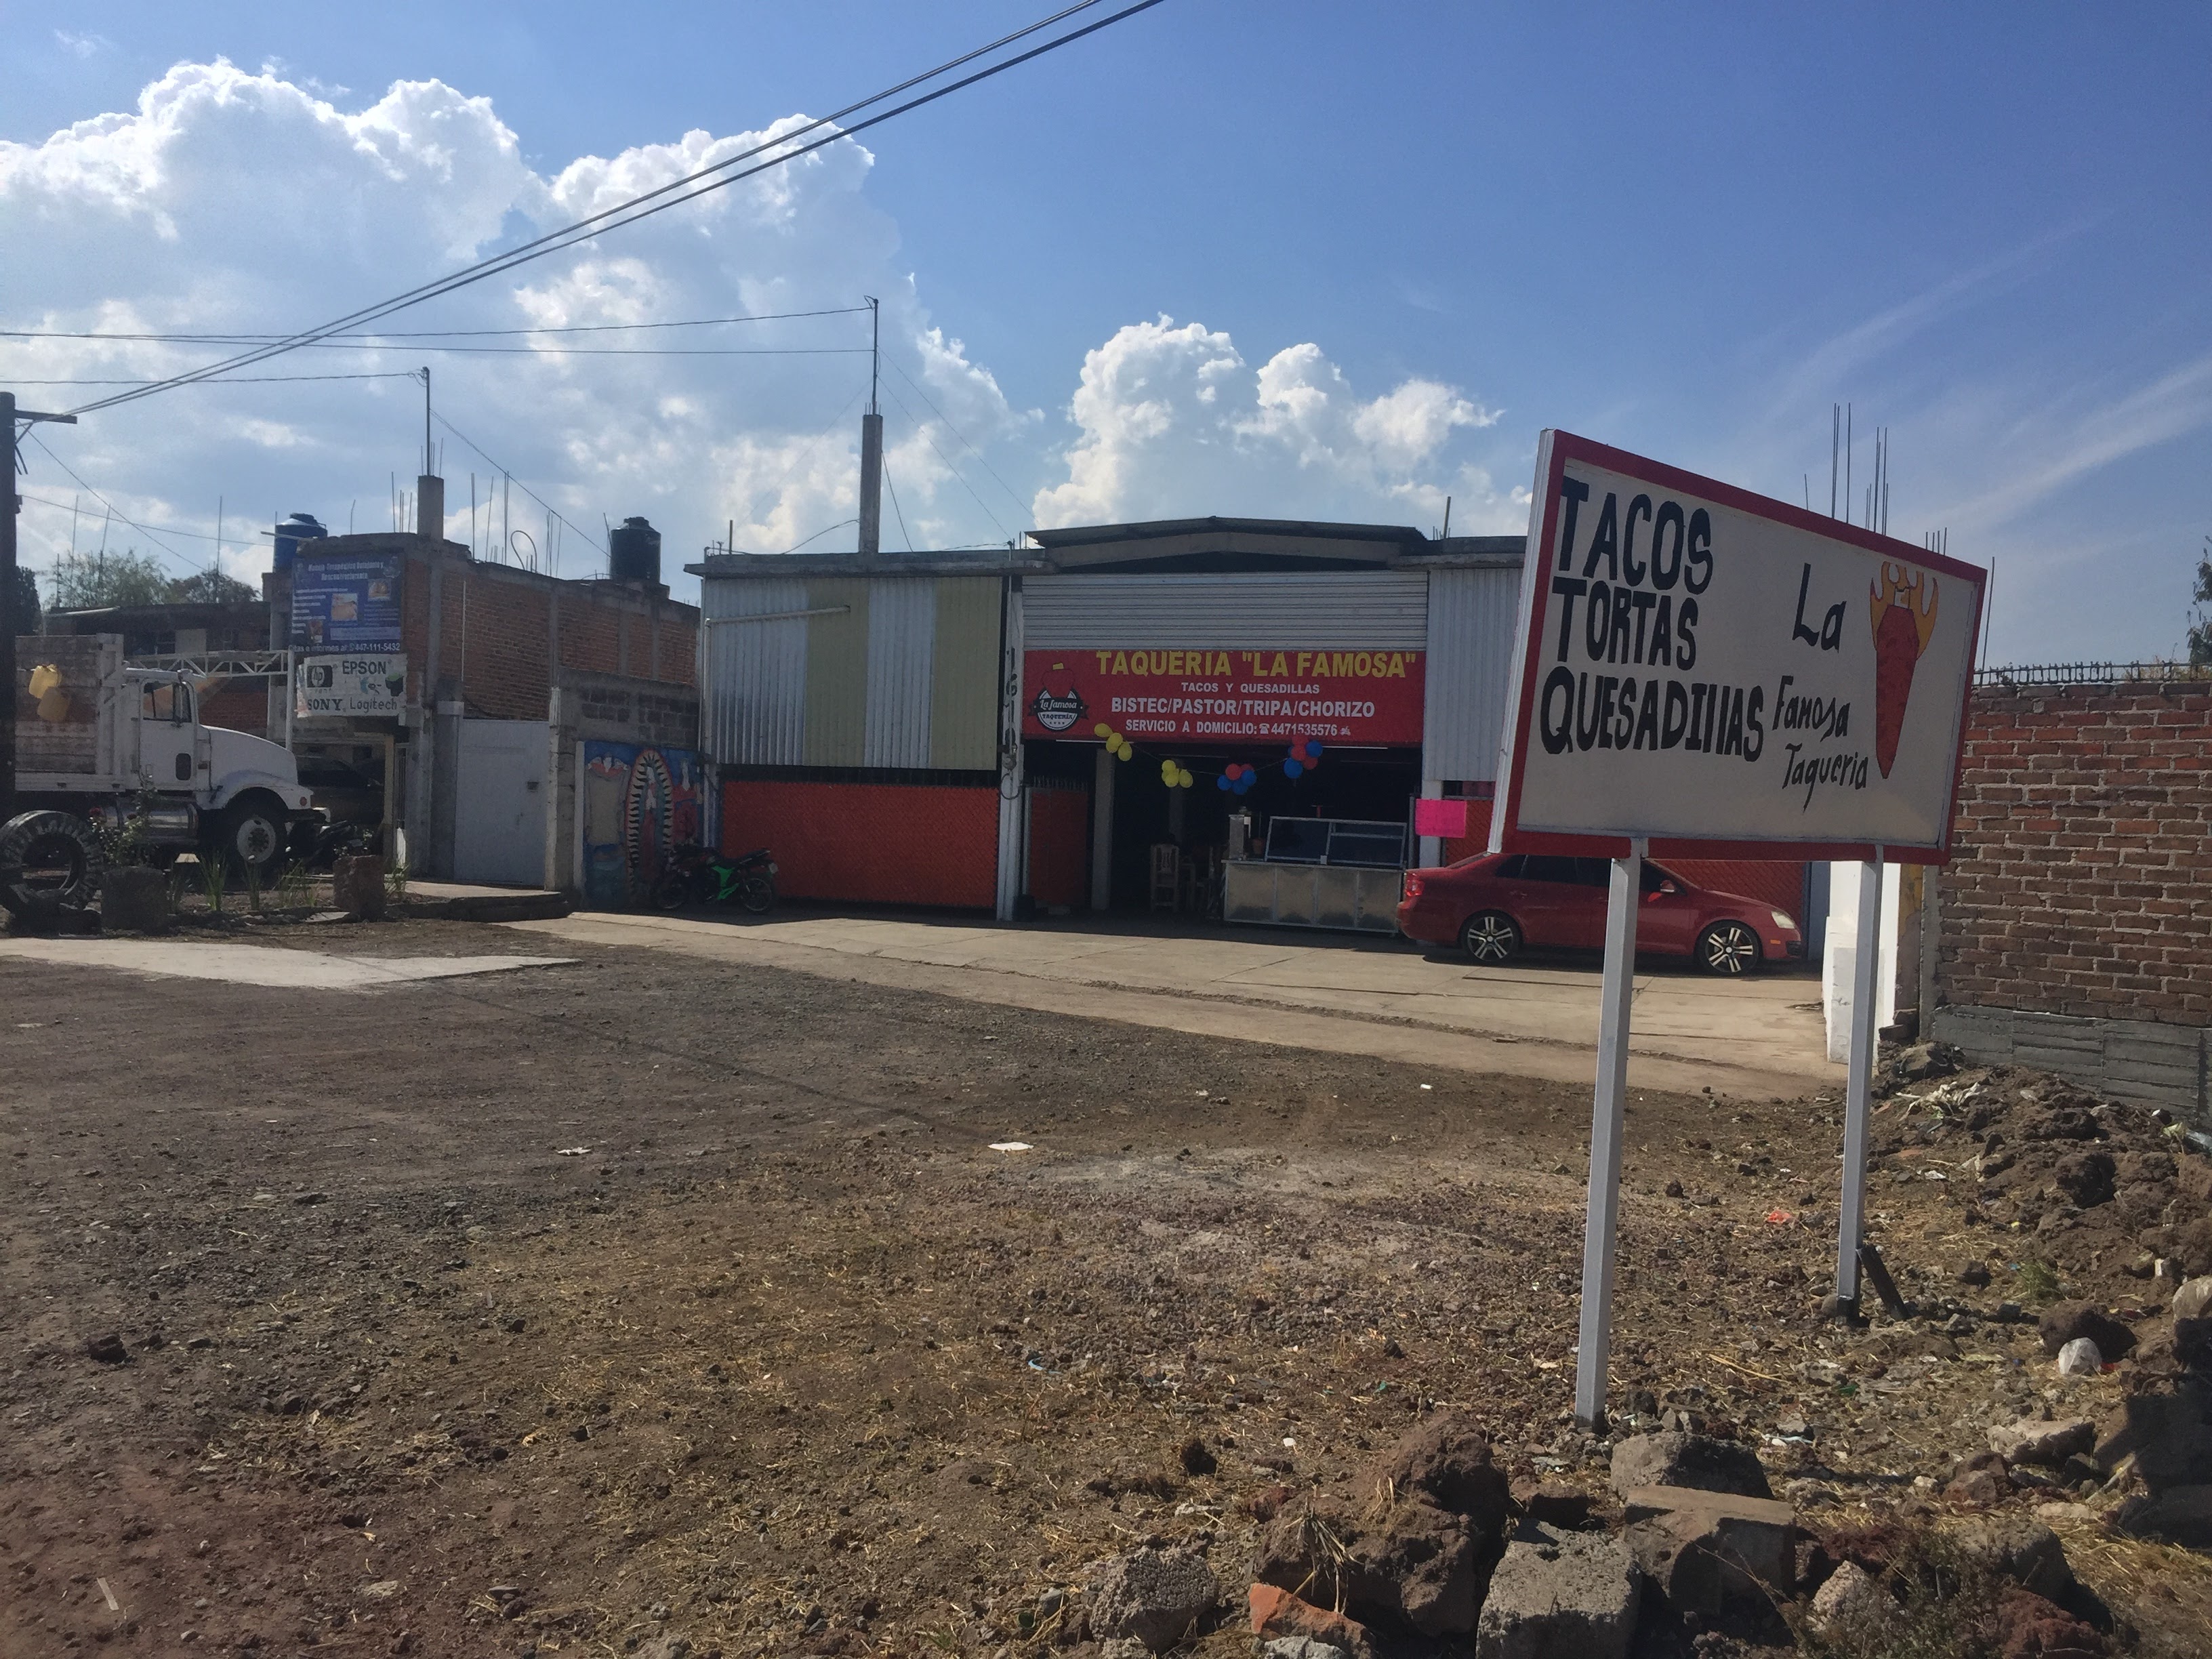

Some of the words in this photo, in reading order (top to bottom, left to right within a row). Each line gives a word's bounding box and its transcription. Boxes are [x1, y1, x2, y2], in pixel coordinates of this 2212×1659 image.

[1559, 475, 1713, 595] TACOS
[1792, 562, 1847, 653] La
[1553, 576, 1698, 671] TORTAS
[342, 661, 387, 674] EPSON
[1097, 651, 1231, 677] TAQUERIA
[1242, 652, 1289, 676] "LA
[1296, 652, 1416, 678] FAMOSA"
[1181, 682, 1218, 693] TACOS
[1225, 683, 1233, 693] Y
[1240, 683, 1320, 694] QUESADILLAS
[307, 699, 343, 711] SONY
[350, 697, 397, 713] Logitech
[1040, 699, 1048, 710] La
[1111, 697, 1375, 718] BISTEC/PASTOR/TRIPA/CHORIZO
[1772, 675, 1851, 742] Famosa
[1126, 719, 1176, 732] SERVICIO
[1182, 720, 1190, 733] A
[1196, 721, 1257, 735] DOMICILIO:
[1271, 722, 1338, 736] 4471535576
[1782, 743, 1868, 814] Taqueria
